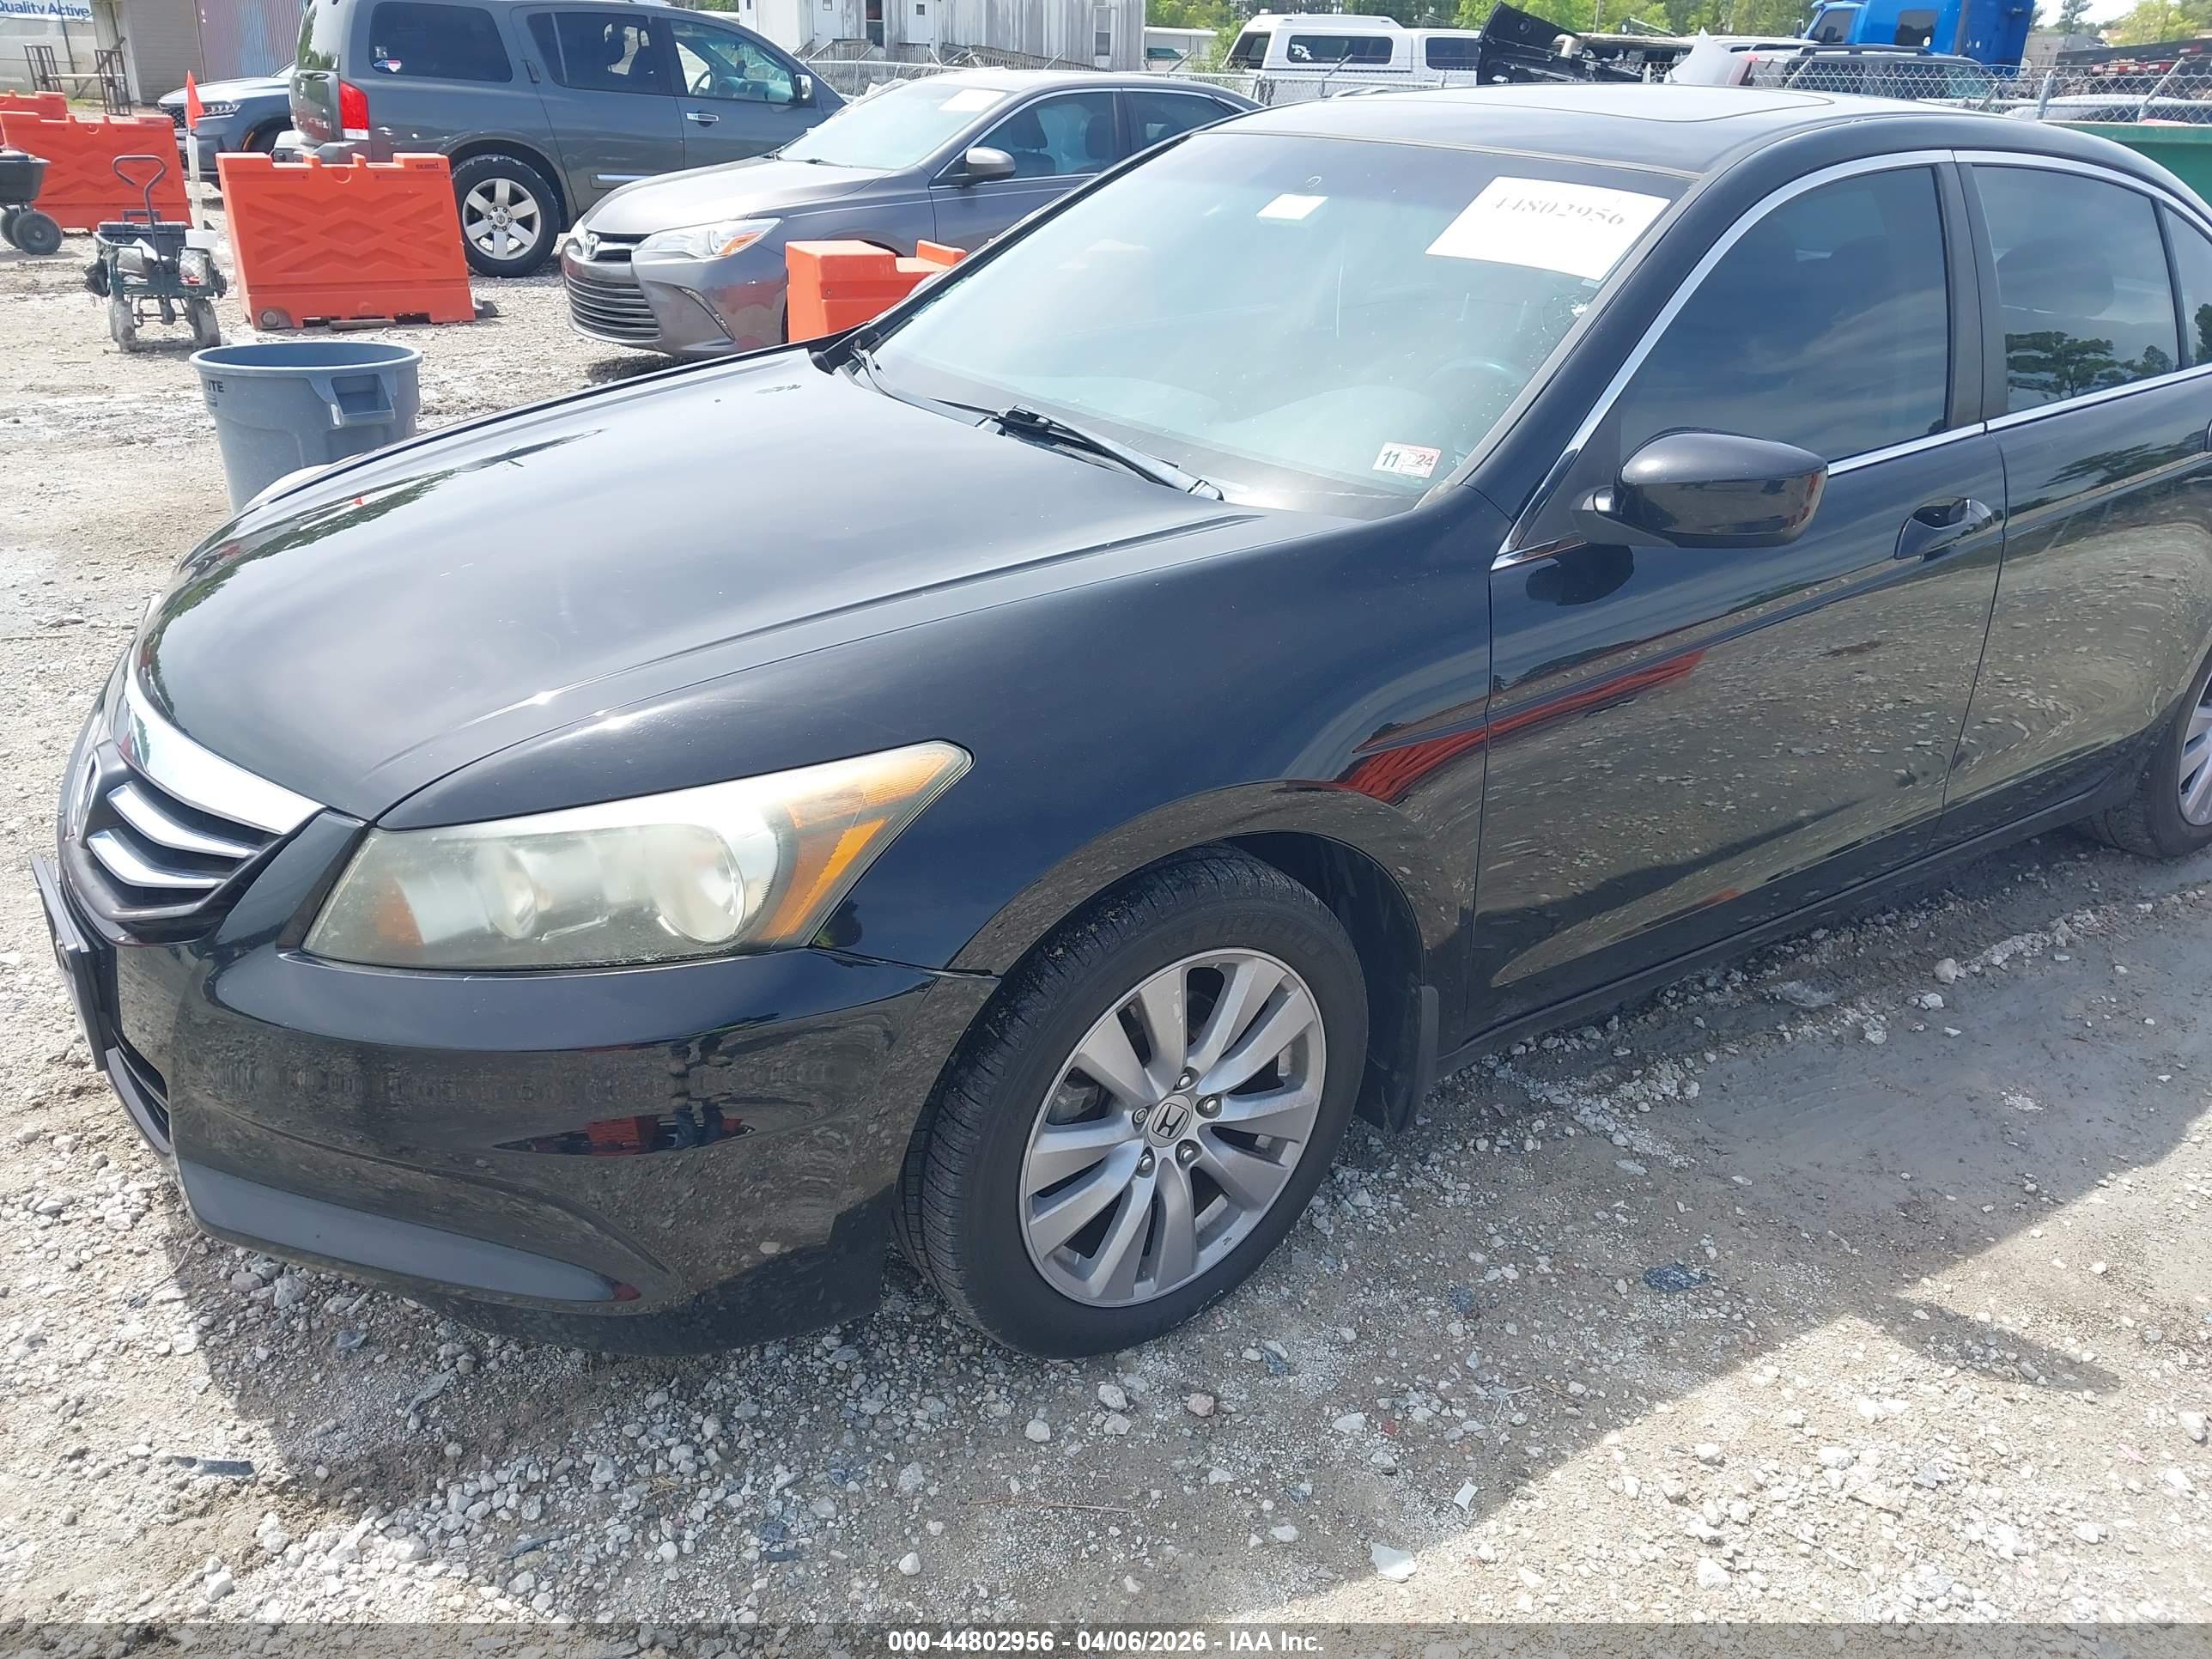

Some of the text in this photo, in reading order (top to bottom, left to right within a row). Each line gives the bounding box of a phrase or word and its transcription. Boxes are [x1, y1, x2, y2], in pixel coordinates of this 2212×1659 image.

[48, 3, 89, 17] Active
[1382, 450, 1435, 468] 11 24
